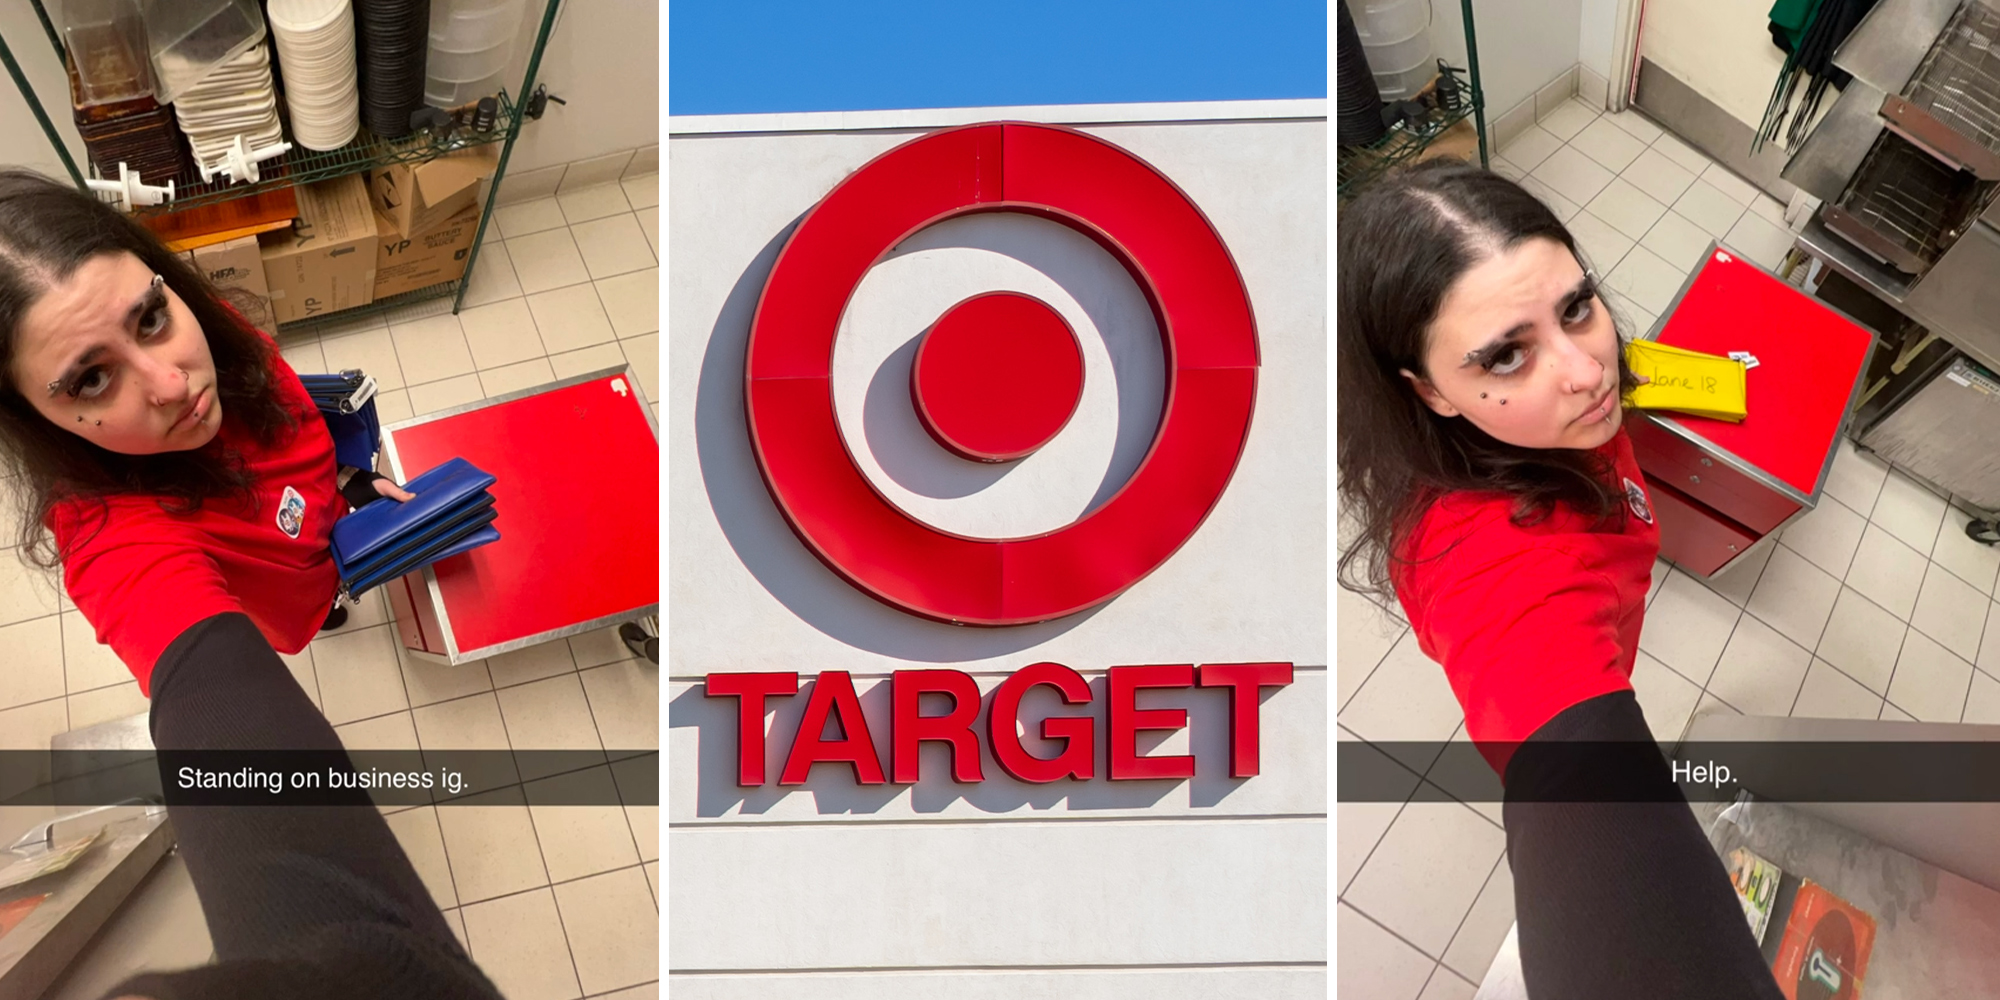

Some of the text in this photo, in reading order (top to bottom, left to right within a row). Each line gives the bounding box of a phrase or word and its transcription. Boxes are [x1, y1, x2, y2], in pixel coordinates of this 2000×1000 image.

[290, 217, 315, 248] YP
[384, 239, 411, 256] YP
[210, 266, 235, 281] HFA
[304, 297, 323, 316] YP
[1648, 366, 1718, 395] Jane 18
[703, 662, 1294, 787] TARGET
